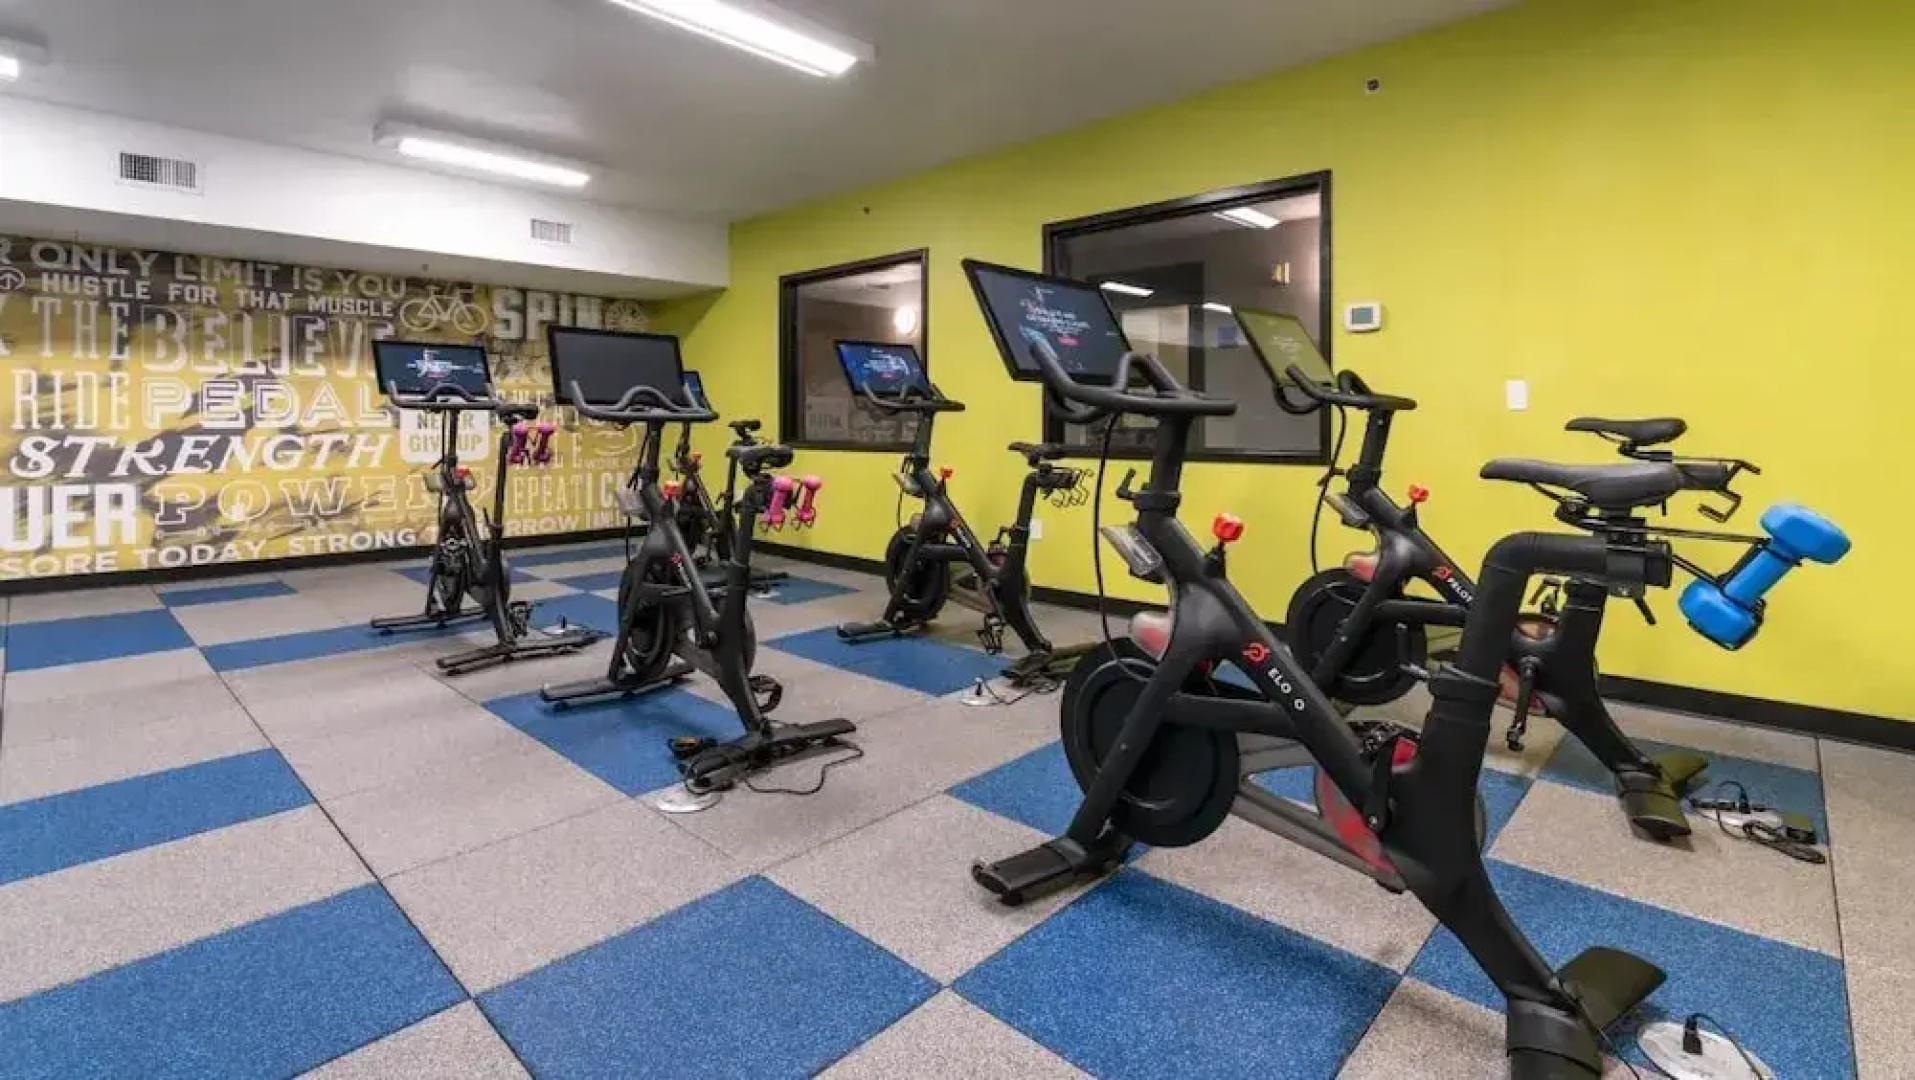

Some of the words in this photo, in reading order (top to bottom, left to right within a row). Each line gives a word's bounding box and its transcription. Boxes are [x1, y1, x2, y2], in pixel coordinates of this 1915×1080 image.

[30, 241, 160, 277] ONLY
[174, 256, 280, 289] LIMIT
[292, 266, 324, 291] IS
[336, 271, 407, 299] YOU
[41, 271, 152, 301] HUSTLE
[168, 281, 217, 304] FOR
[236, 288, 292, 312] THAT
[307, 297, 394, 317] MUSCLE
[31, 296, 131, 360] THE
[11, 368, 131, 431] RIDE
[142, 376, 394, 431] PEDAL
[9, 434, 394, 479] STRENGTH
[512, 474, 583, 514] EPEAT
[0, 550, 118, 578] SORE
[134, 539, 267, 568] TODAY
[288, 528, 416, 554] STRONG
